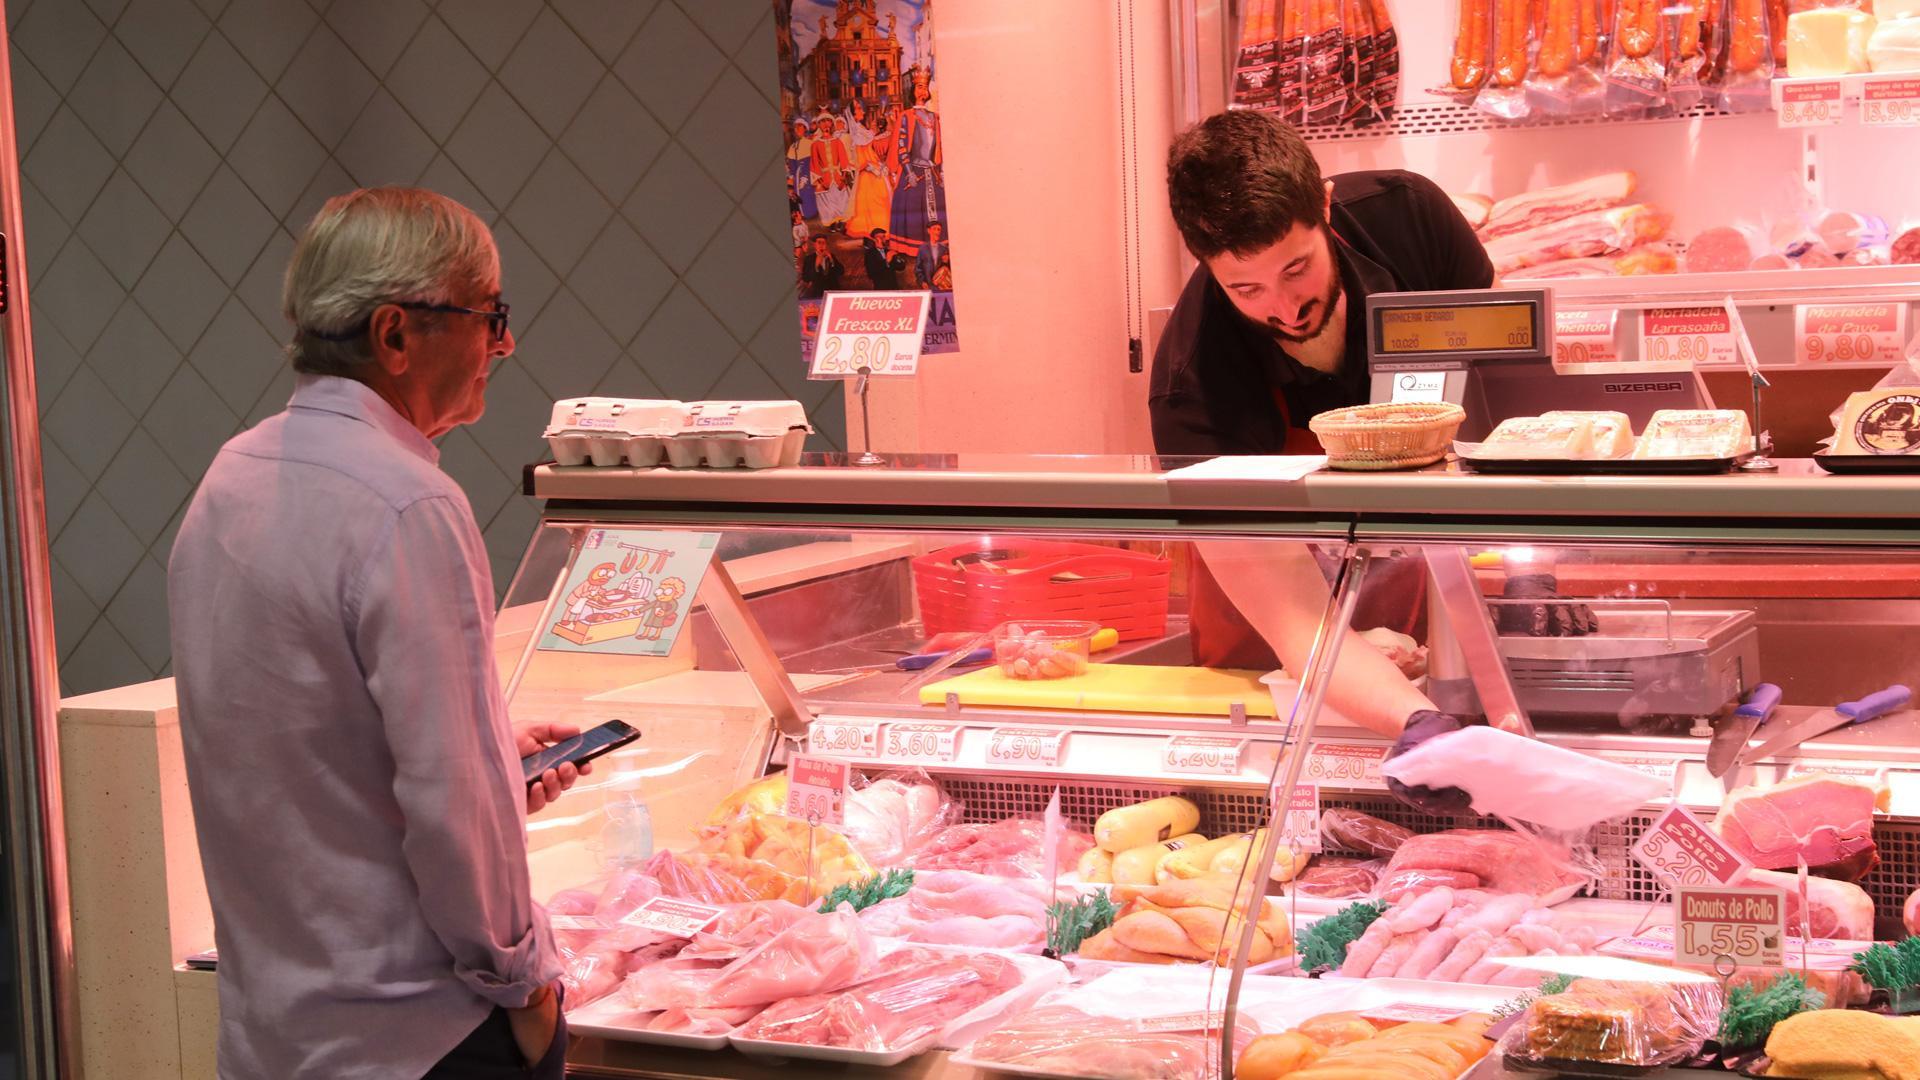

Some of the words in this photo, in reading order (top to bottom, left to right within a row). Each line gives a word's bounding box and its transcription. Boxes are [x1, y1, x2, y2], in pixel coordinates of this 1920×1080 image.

[1782, 101, 1829, 122] 8,40
[1863, 100, 1911, 122] 13,90
[849, 296, 903, 310] Huevos
[1651, 307, 1721, 319] Mortadela
[1807, 306, 1888, 318] Mortadela
[834, 318, 891, 331] Frescos
[894, 317, 913, 331] XL
[1556, 322, 1606, 333] mentón
[1651, 322, 1726, 335] Larrasoaña
[820, 336, 890, 372] 2,80
[1805, 334, 1874, 362] 9,80
[1604, 382, 1682, 393] BIZERBA
[812, 726, 860, 750] 4,20
[888, 731, 938, 756] 3,60
[1308, 756, 1364, 780] 8,20
[1680, 822, 1726, 863] Alas
[1687, 895, 1726, 919] Donuts
[1728, 897, 1744, 919] de
[1745, 897, 1775, 921] Pollo
[1681, 922, 1759, 957] 1,55
